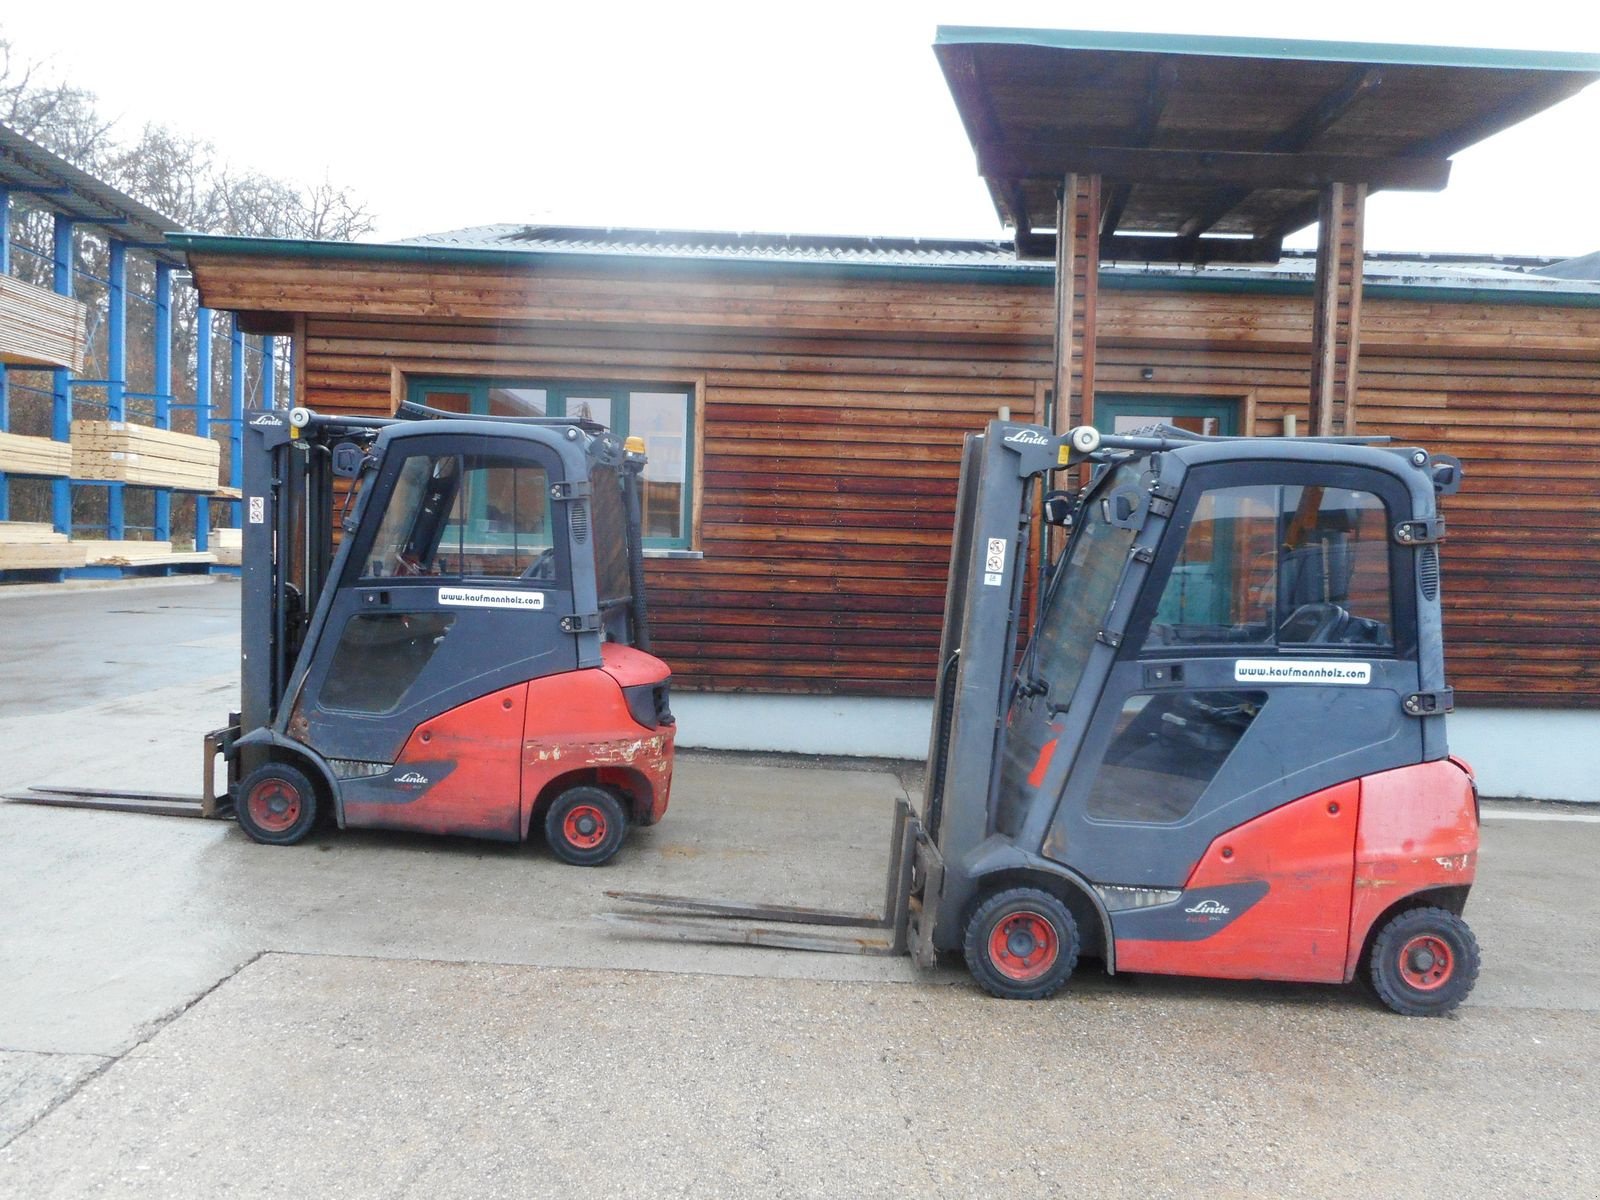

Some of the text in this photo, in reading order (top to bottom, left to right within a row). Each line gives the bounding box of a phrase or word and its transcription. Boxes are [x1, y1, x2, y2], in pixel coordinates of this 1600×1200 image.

[249, 415, 283, 425] Linde
[1004, 430, 1049, 445] Linde
[441, 593, 541, 605] www.kaufmannholz.com
[1239, 667, 1366, 679] www.kaufmannholz.com
[394, 772, 429, 783] Linde
[1185, 900, 1230, 914] Linde
